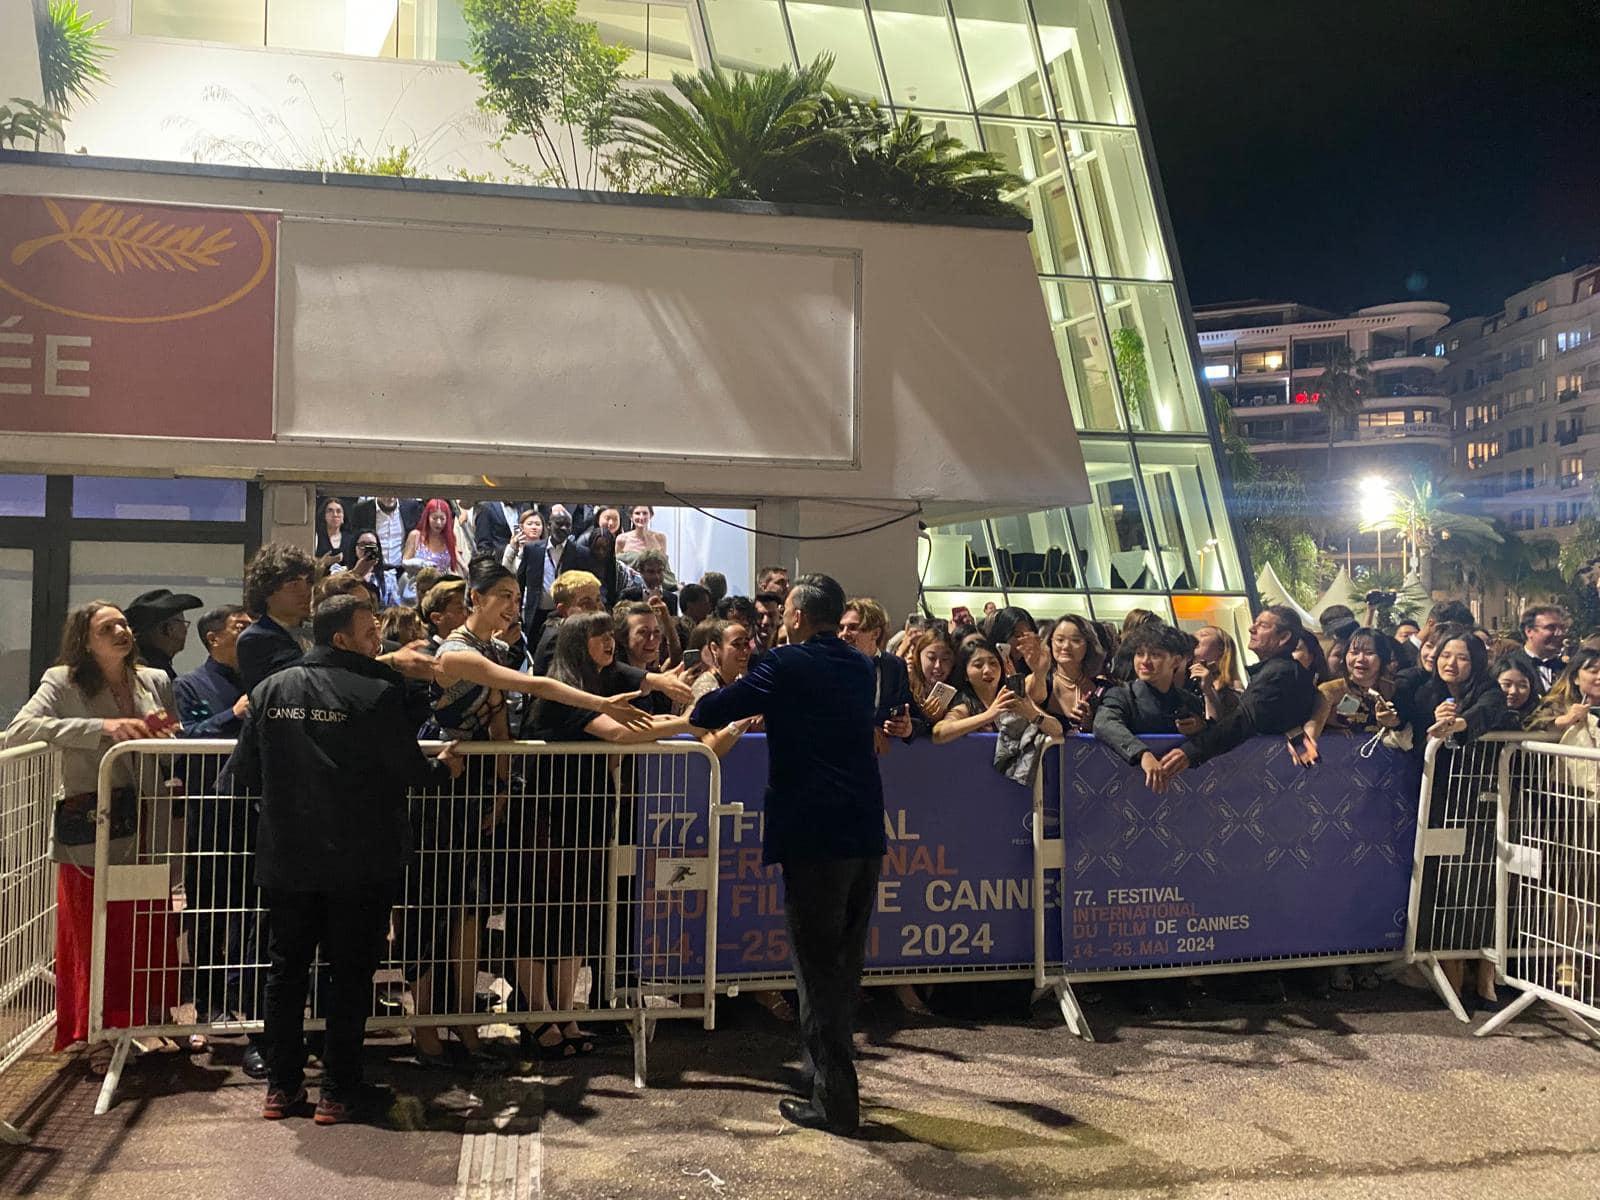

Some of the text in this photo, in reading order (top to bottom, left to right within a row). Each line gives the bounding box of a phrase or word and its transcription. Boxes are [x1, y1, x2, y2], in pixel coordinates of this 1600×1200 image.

[267, 707, 306, 720] CANNES
[648, 812, 705, 845] 77.
[731, 884, 788, 918] FIL
[876, 880, 902, 913] E
[925, 878, 1062, 912] CANNE
[1073, 886, 1185, 906] 77. FESTIVAL
[1072, 903, 1201, 923] INTERNATIONAL
[1073, 914, 1251, 940] DU FILM DE CANNES
[901, 922, 995, 957] 2024
[1140, 939, 1169, 956] MAI
[1176, 935, 1216, 954] 2024
